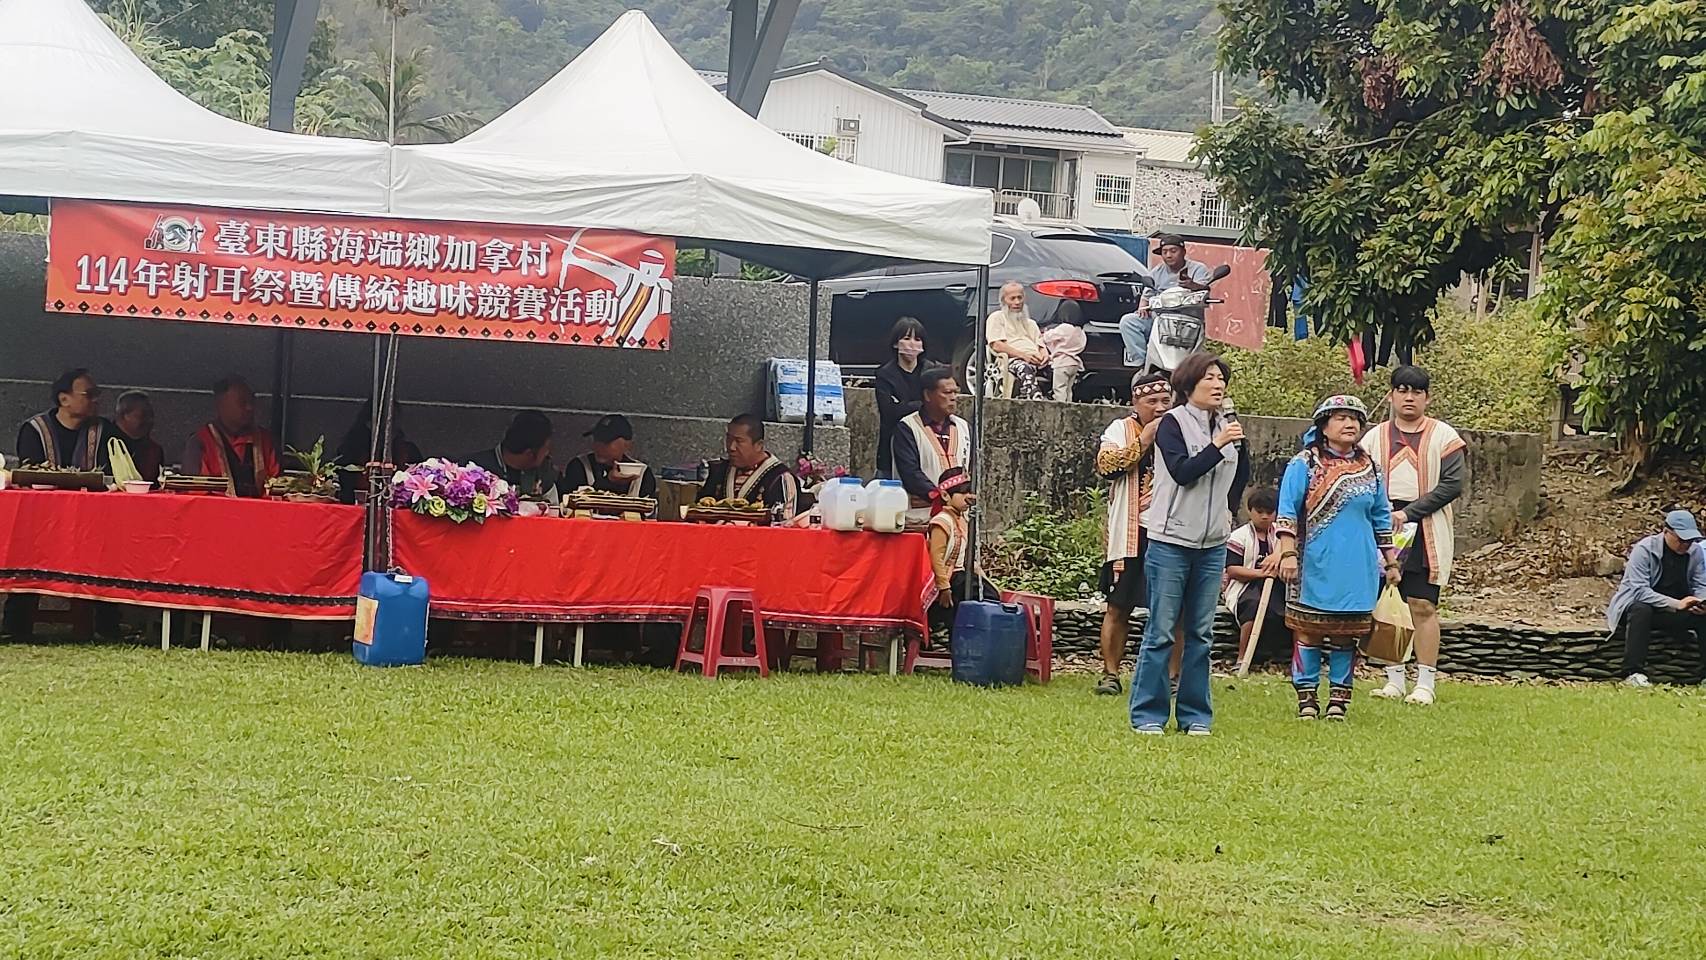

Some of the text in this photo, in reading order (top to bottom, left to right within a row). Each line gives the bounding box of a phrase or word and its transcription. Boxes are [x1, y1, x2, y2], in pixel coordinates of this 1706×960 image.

[213, 220, 551, 276] 臺東縣海端鄉加拿村
[76, 254, 619, 326] 114年射耳祭暨傳統趣味競賽活動
